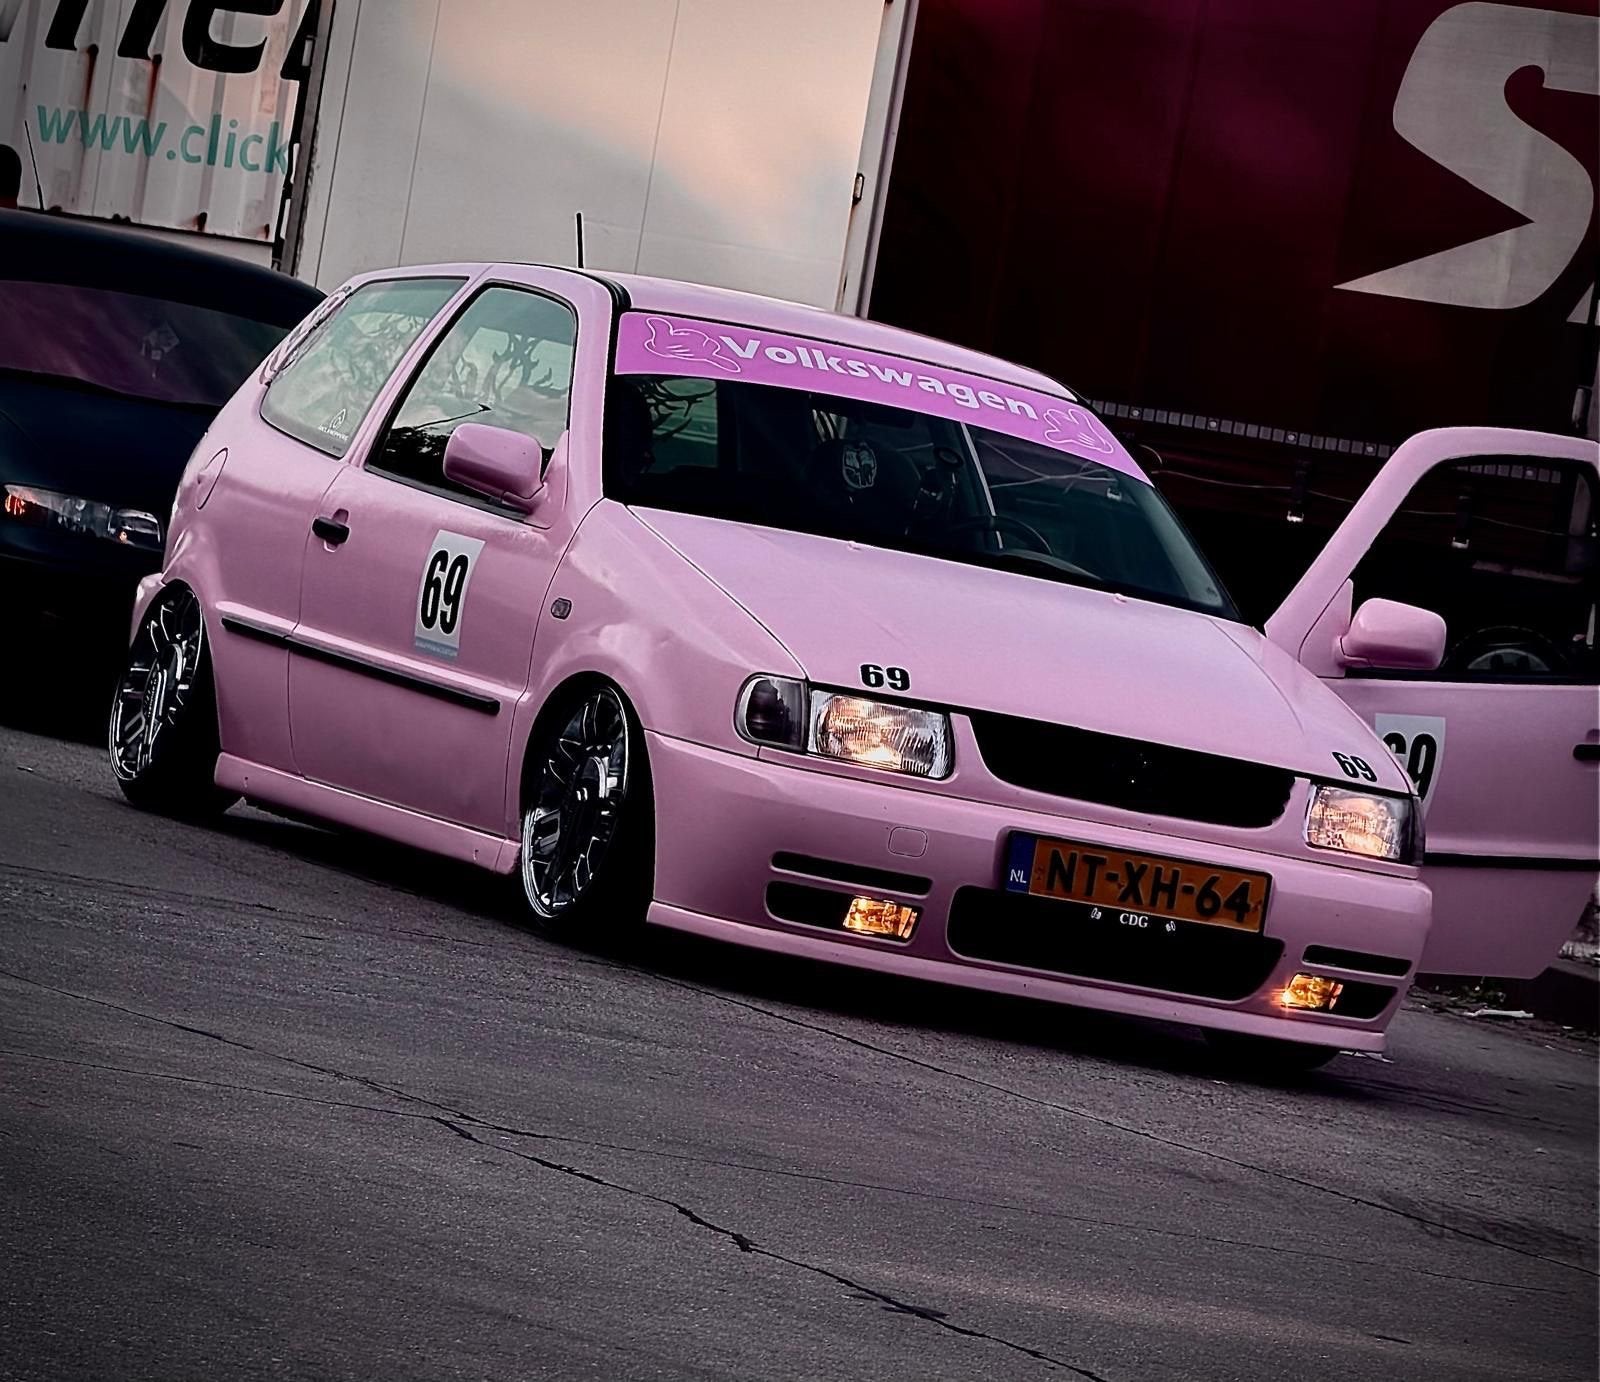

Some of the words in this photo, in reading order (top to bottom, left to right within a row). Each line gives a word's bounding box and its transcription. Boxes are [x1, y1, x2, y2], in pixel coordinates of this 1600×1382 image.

[37, 104, 289, 176] www.click
[719, 335, 1039, 422] Volkswagen
[420, 549, 469, 635] 69
[859, 663, 911, 692] 69
[1331, 751, 1378, 783] 69
[1382, 731, 1438, 804] 9
[1009, 868, 1027, 884] NL
[1046, 848, 1253, 924] NT-XH-64
[1119, 912, 1149, 929] CDG
